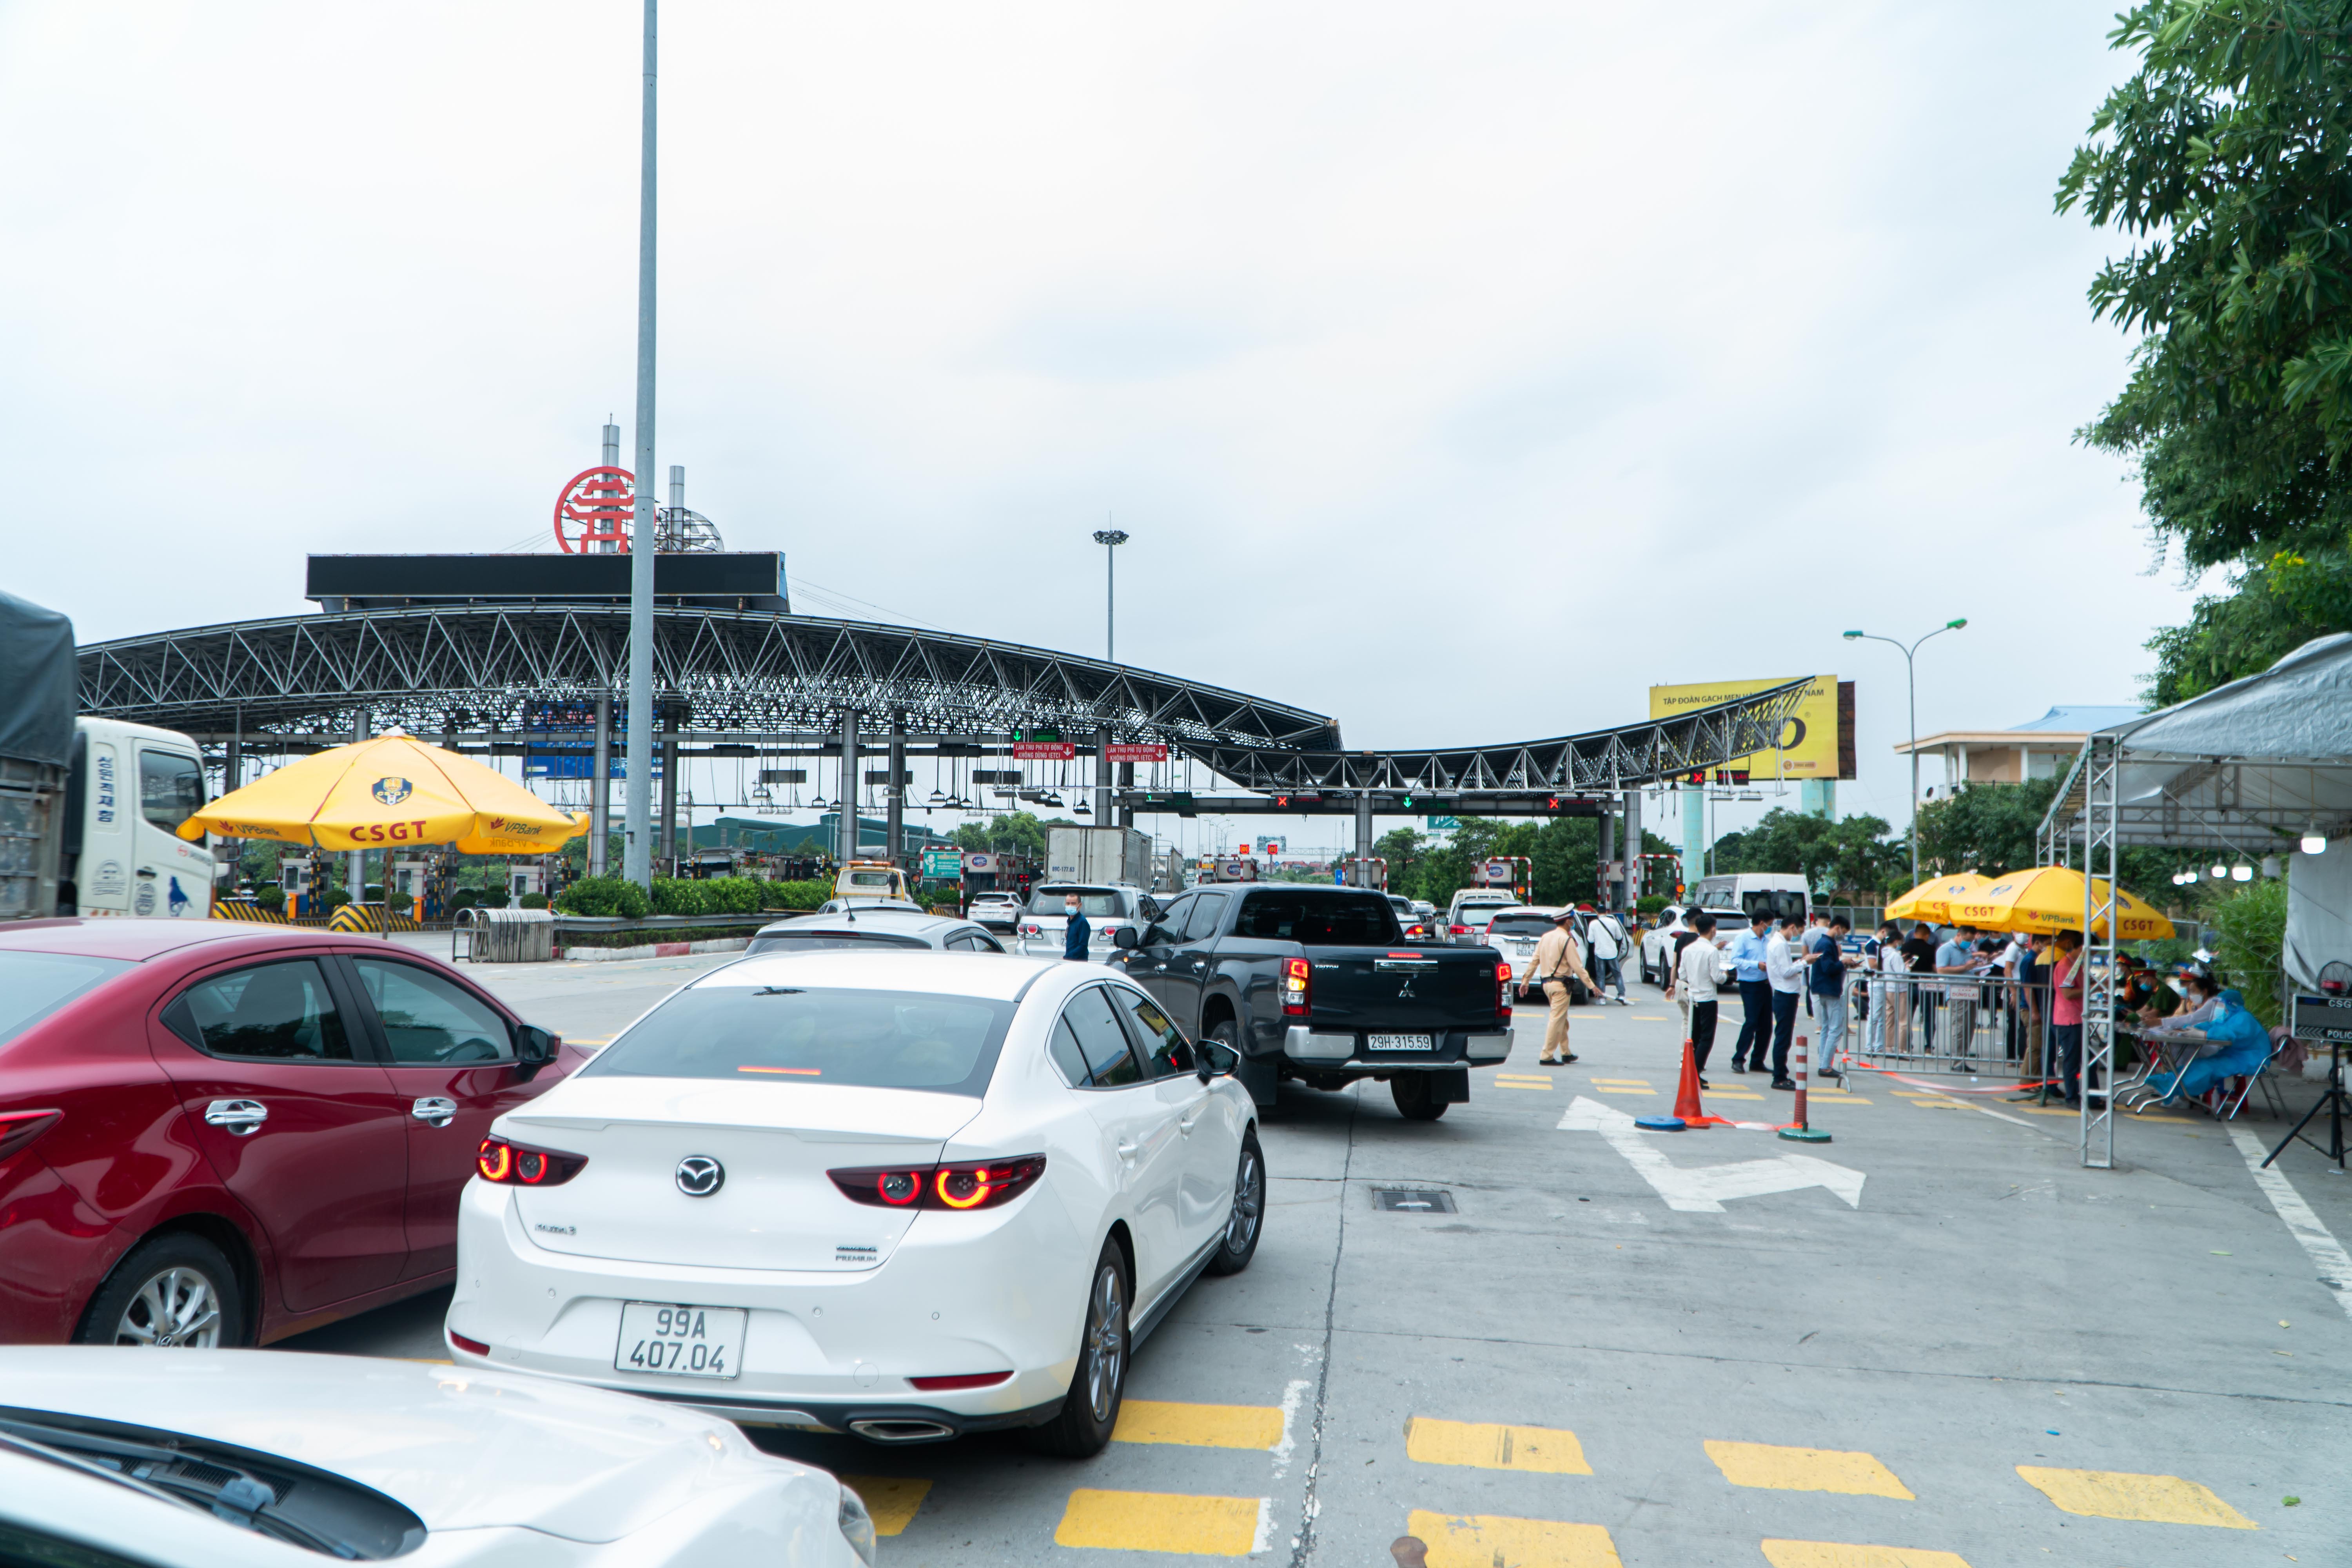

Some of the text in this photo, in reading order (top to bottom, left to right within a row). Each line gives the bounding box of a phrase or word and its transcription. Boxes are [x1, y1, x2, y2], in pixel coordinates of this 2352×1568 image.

[1678, 695, 1700, 704] ĐOÀN
[1702, 695, 1722, 704] GẠCH
[349, 820, 426, 842] CSGT
[505, 822, 543, 835] VPBank
[1964, 907, 1995, 916] CSGT
[2041, 914, 2075, 925] VPBank
[2123, 919, 2154, 931] CSGT
[1371, 1036, 1430, 1049] 29H-315.59
[655, 1309, 705, 1339] 99A
[630, 1340, 724, 1373] 407.04
